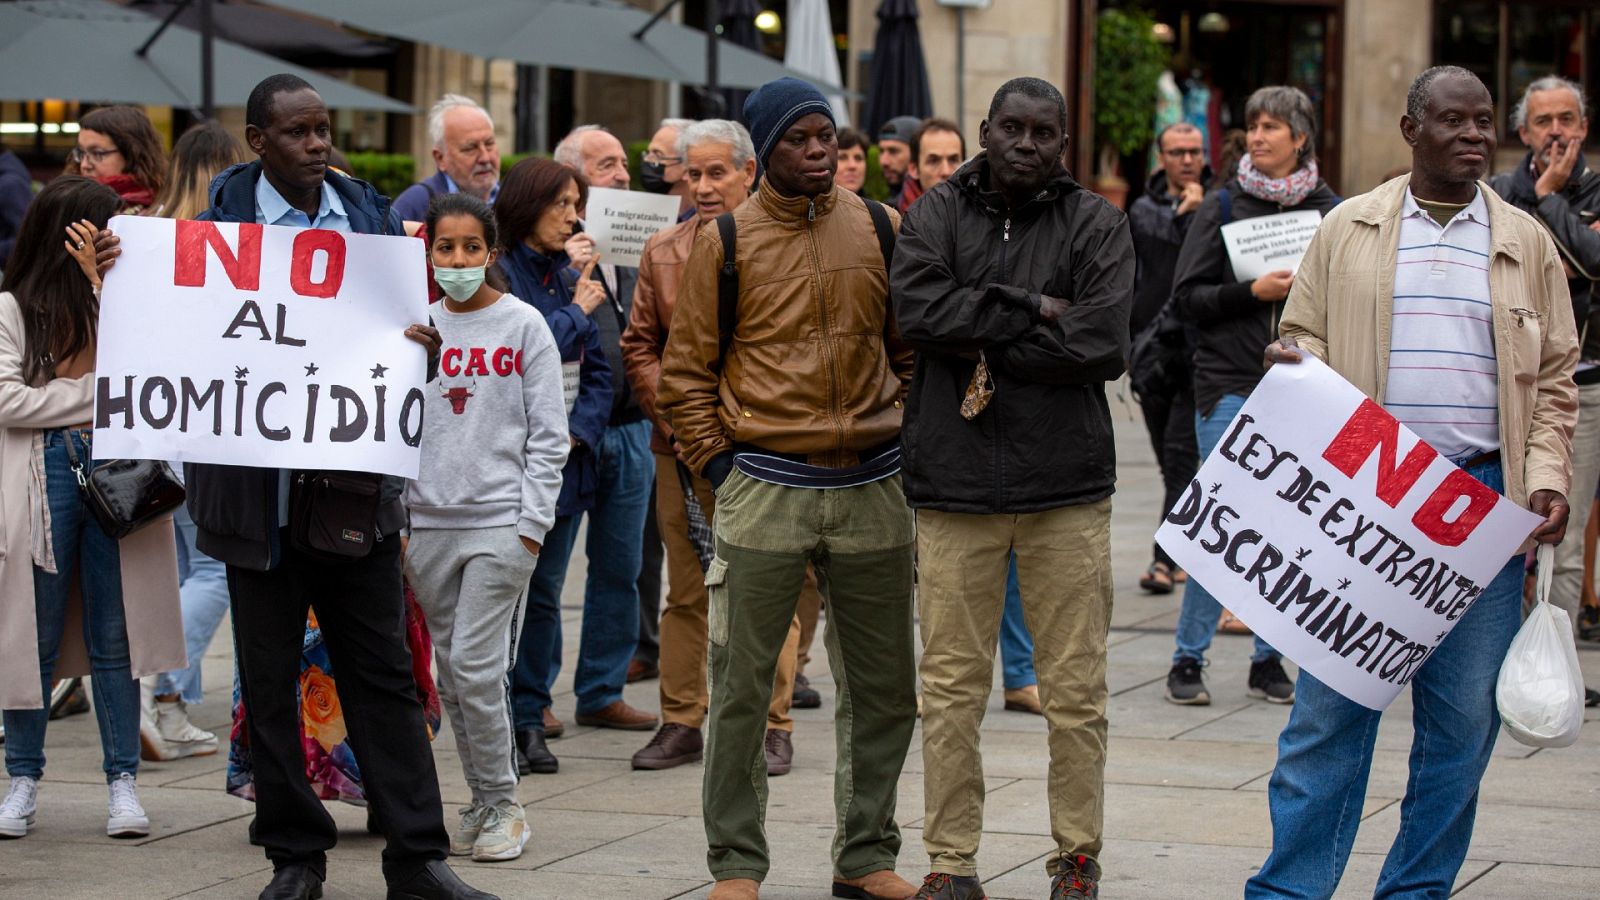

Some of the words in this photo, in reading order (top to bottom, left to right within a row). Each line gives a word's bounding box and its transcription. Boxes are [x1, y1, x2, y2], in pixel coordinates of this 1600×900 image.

[604, 208, 615, 216] Ez
[617, 210, 668, 222] migratzaileen
[611, 223, 643, 232] aurkako
[1236, 231, 1283, 245] Espainiako
[173, 219, 347, 299] NO
[1240, 242, 1269, 255] mugak
[222, 299, 306, 347] AL
[95, 363, 425, 448] HOMICIDIO
[1275, 465, 1331, 516] DE
[1322, 398, 1499, 547] NO
